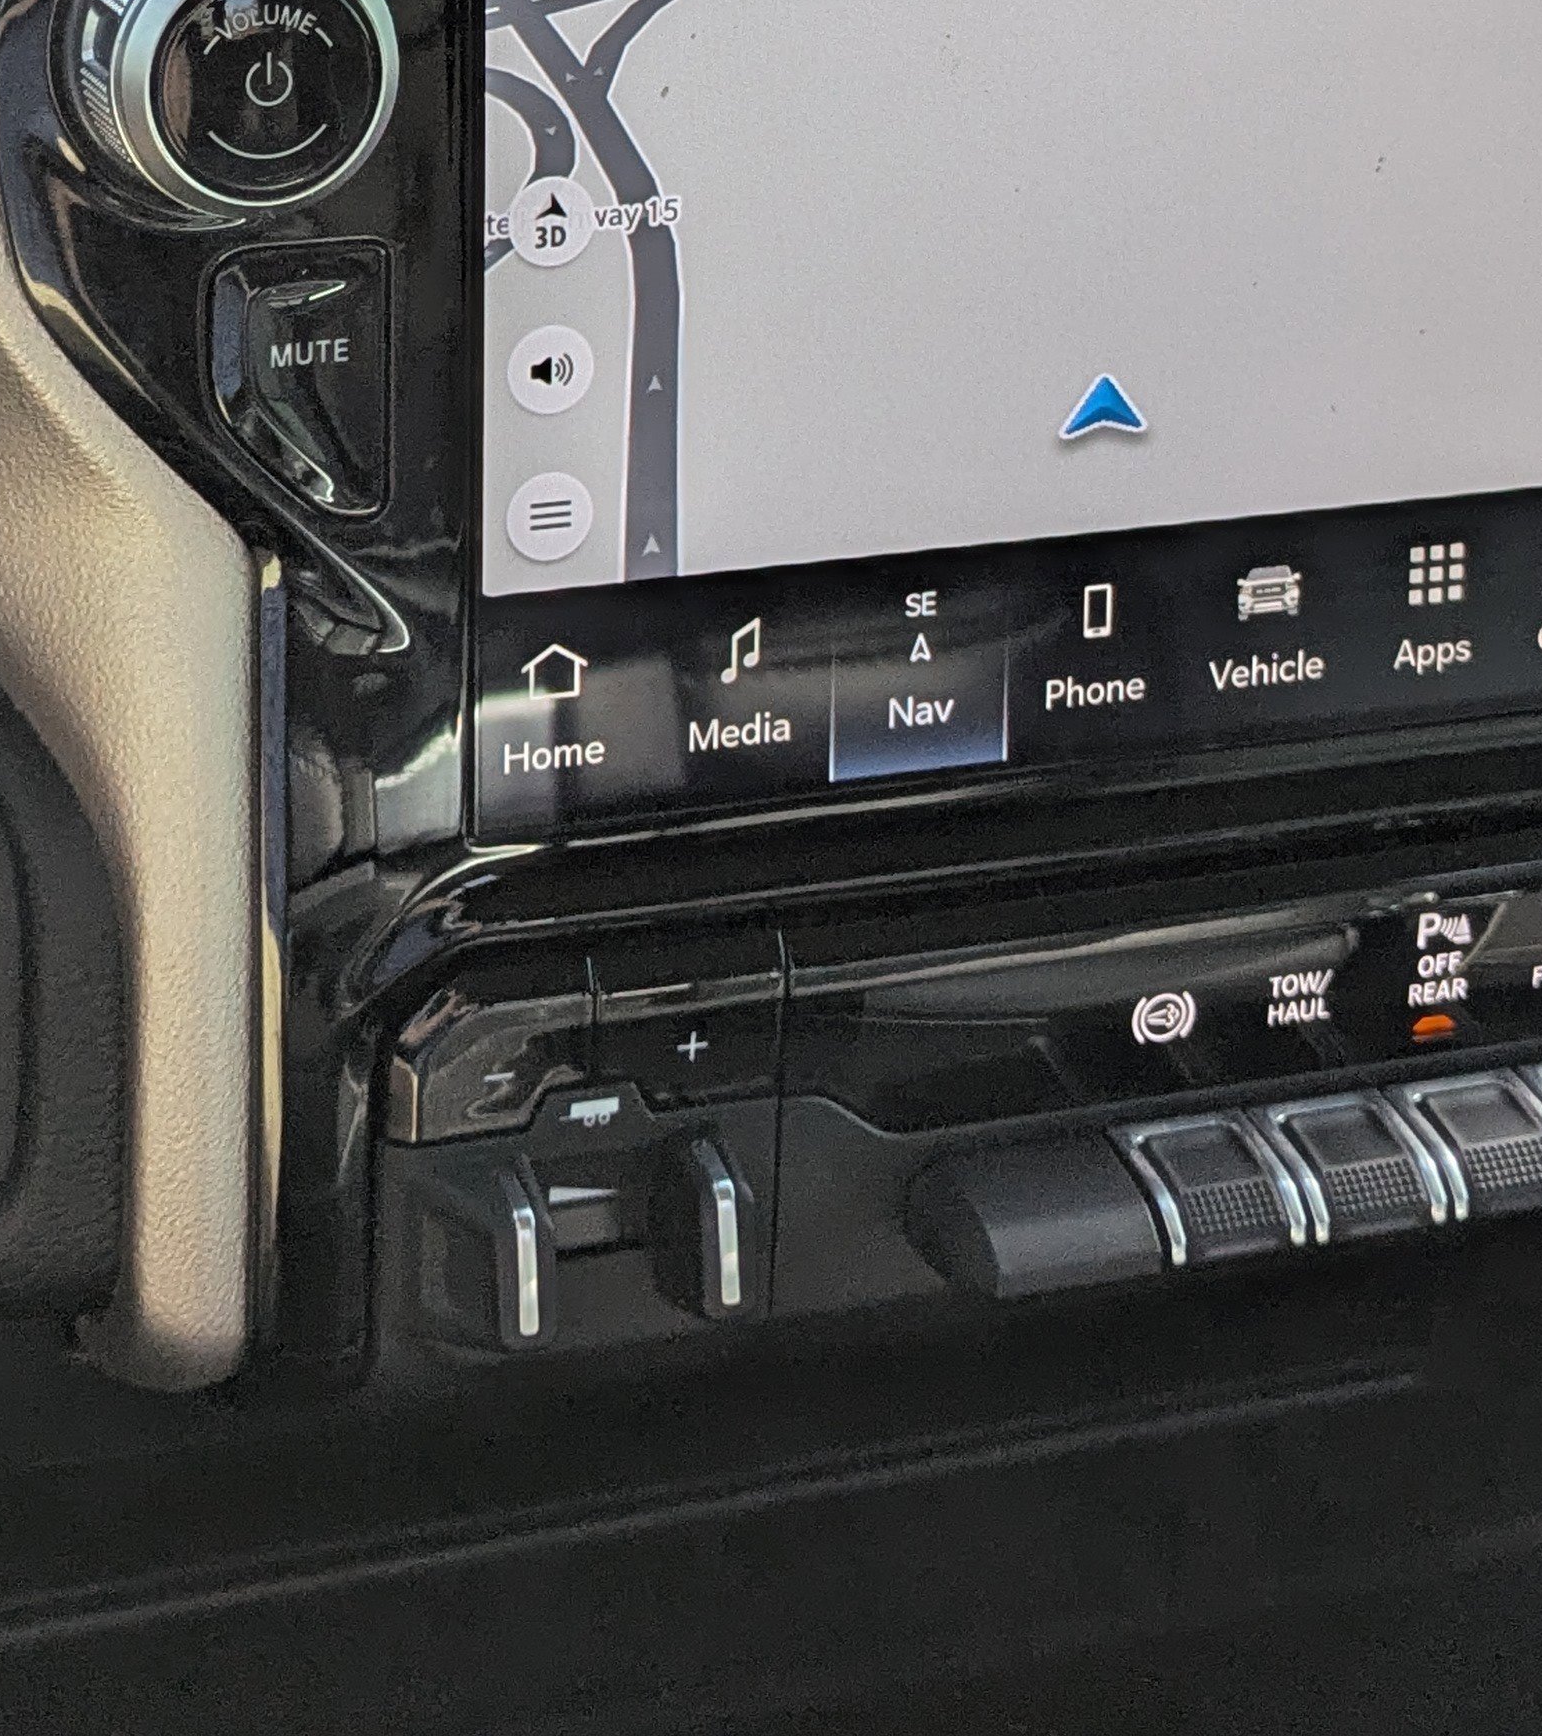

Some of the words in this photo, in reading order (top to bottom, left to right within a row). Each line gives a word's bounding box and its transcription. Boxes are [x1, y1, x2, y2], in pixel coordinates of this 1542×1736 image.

[214, 3, 319, 42] VOLUME
[647, 197, 679, 223] 15
[535, 226, 567, 249] 3D
[270, 338, 350, 368] MUTE
[905, 591, 937, 617] SE
[1209, 650, 1325, 692] Vehicle
[1394, 636, 1472, 675] Apps
[1045, 672, 1146, 711] Phone
[888, 696, 955, 729] Nav
[688, 713, 791, 753] Media
[503, 739, 606, 774] Home
[1417, 951, 1461, 980] OFF
[1269, 969, 1334, 1000] TOW/
[1407, 977, 1468, 1007] REAR
[1267, 993, 1331, 1026] HAUL
